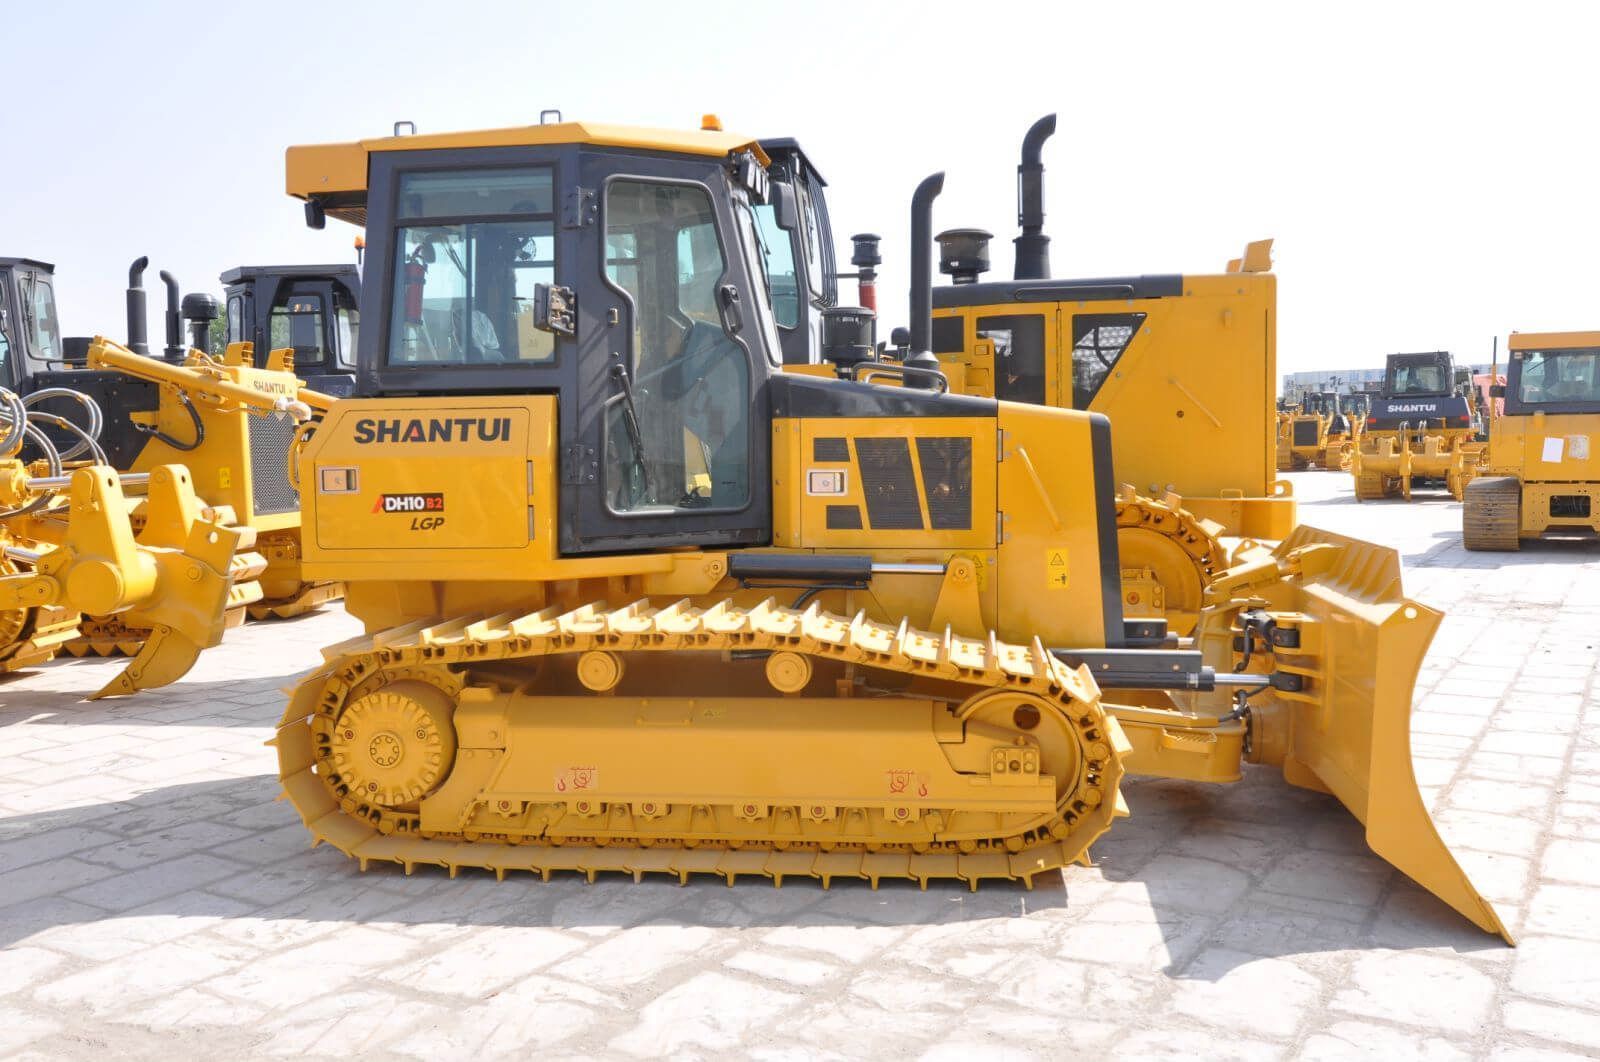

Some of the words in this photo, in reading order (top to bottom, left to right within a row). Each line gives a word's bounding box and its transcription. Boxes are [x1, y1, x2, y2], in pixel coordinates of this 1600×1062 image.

[253, 380, 286, 394] SHANTUI
[1387, 404, 1437, 413] SHANTUI
[353, 418, 512, 444] SHANTUI
[385, 496, 425, 511] DH10
[410, 517, 445, 531] LGP
